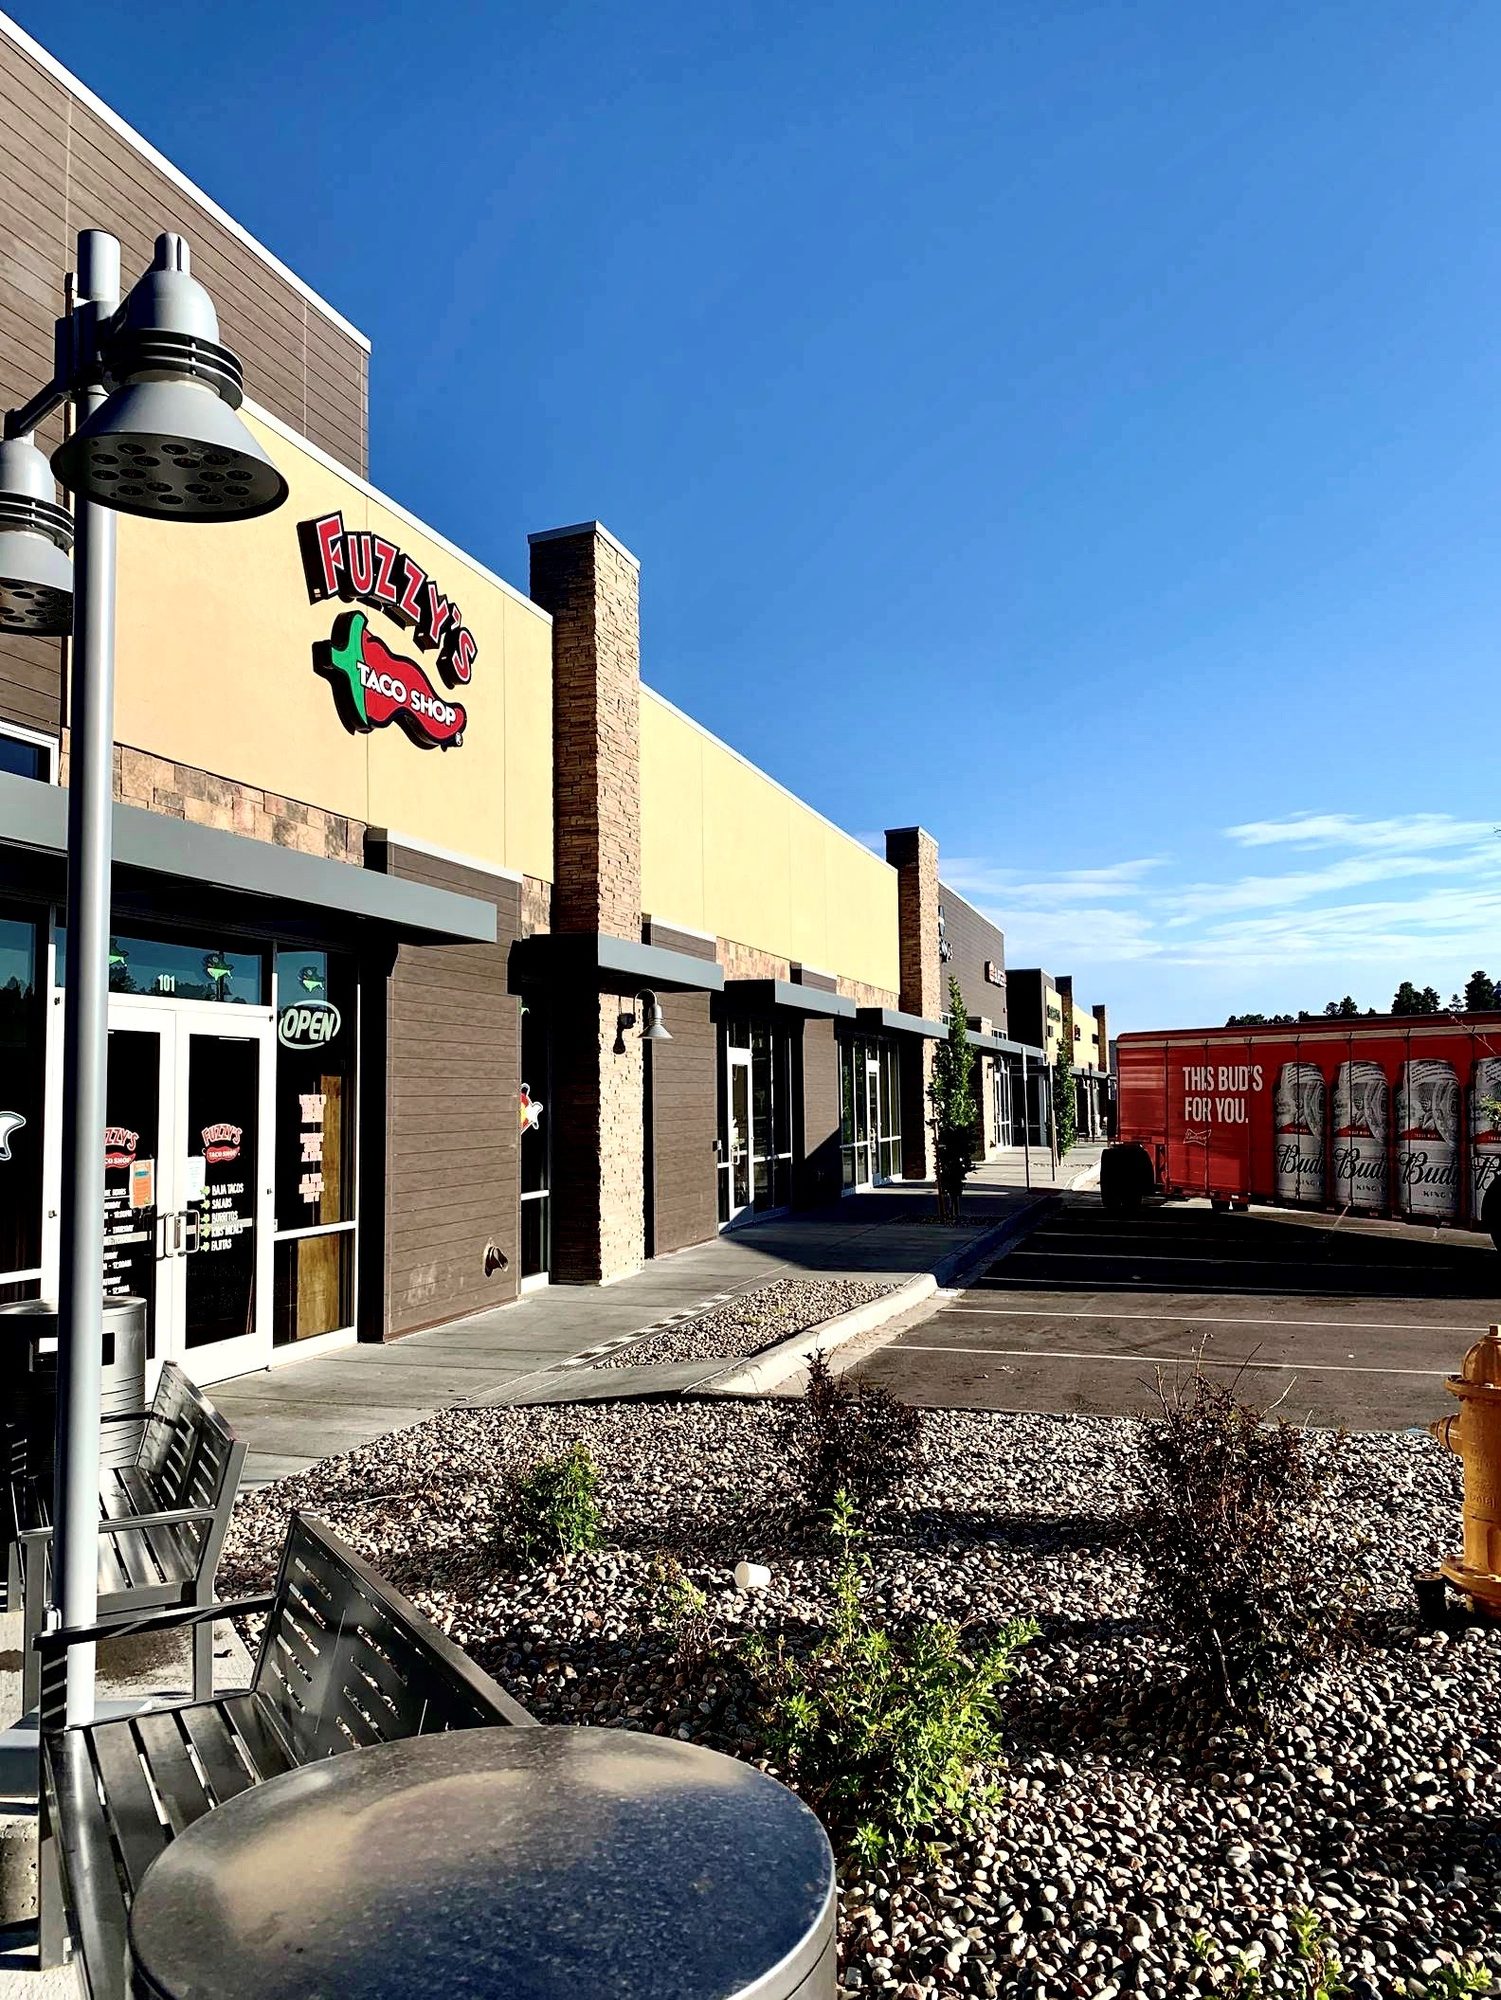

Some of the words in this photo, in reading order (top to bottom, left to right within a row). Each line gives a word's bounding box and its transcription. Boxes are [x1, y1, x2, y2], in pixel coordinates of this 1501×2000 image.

[310, 510, 478, 686] FUZZY'S
[356, 661, 408, 704] TACO
[410, 689, 457, 727] SHOP
[157, 974, 176, 992] 101
[282, 1008, 336, 1042] OPEN
[1182, 1066, 1215, 1092] THIS
[1218, 1064, 1264, 1092] BUD'S
[1184, 1096, 1213, 1123] FOR
[1215, 1097, 1249, 1124] YOU.
[104, 1127, 140, 1152] ZZY'S
[201, 1123, 243, 1147] FUZZY'S
[227, 1183, 244, 1195] TACOS
[211, 1198, 232, 1209] SALADS
[211, 1211, 239, 1223] BURRITOS
[210, 1239, 232, 1252] FAJITAS
